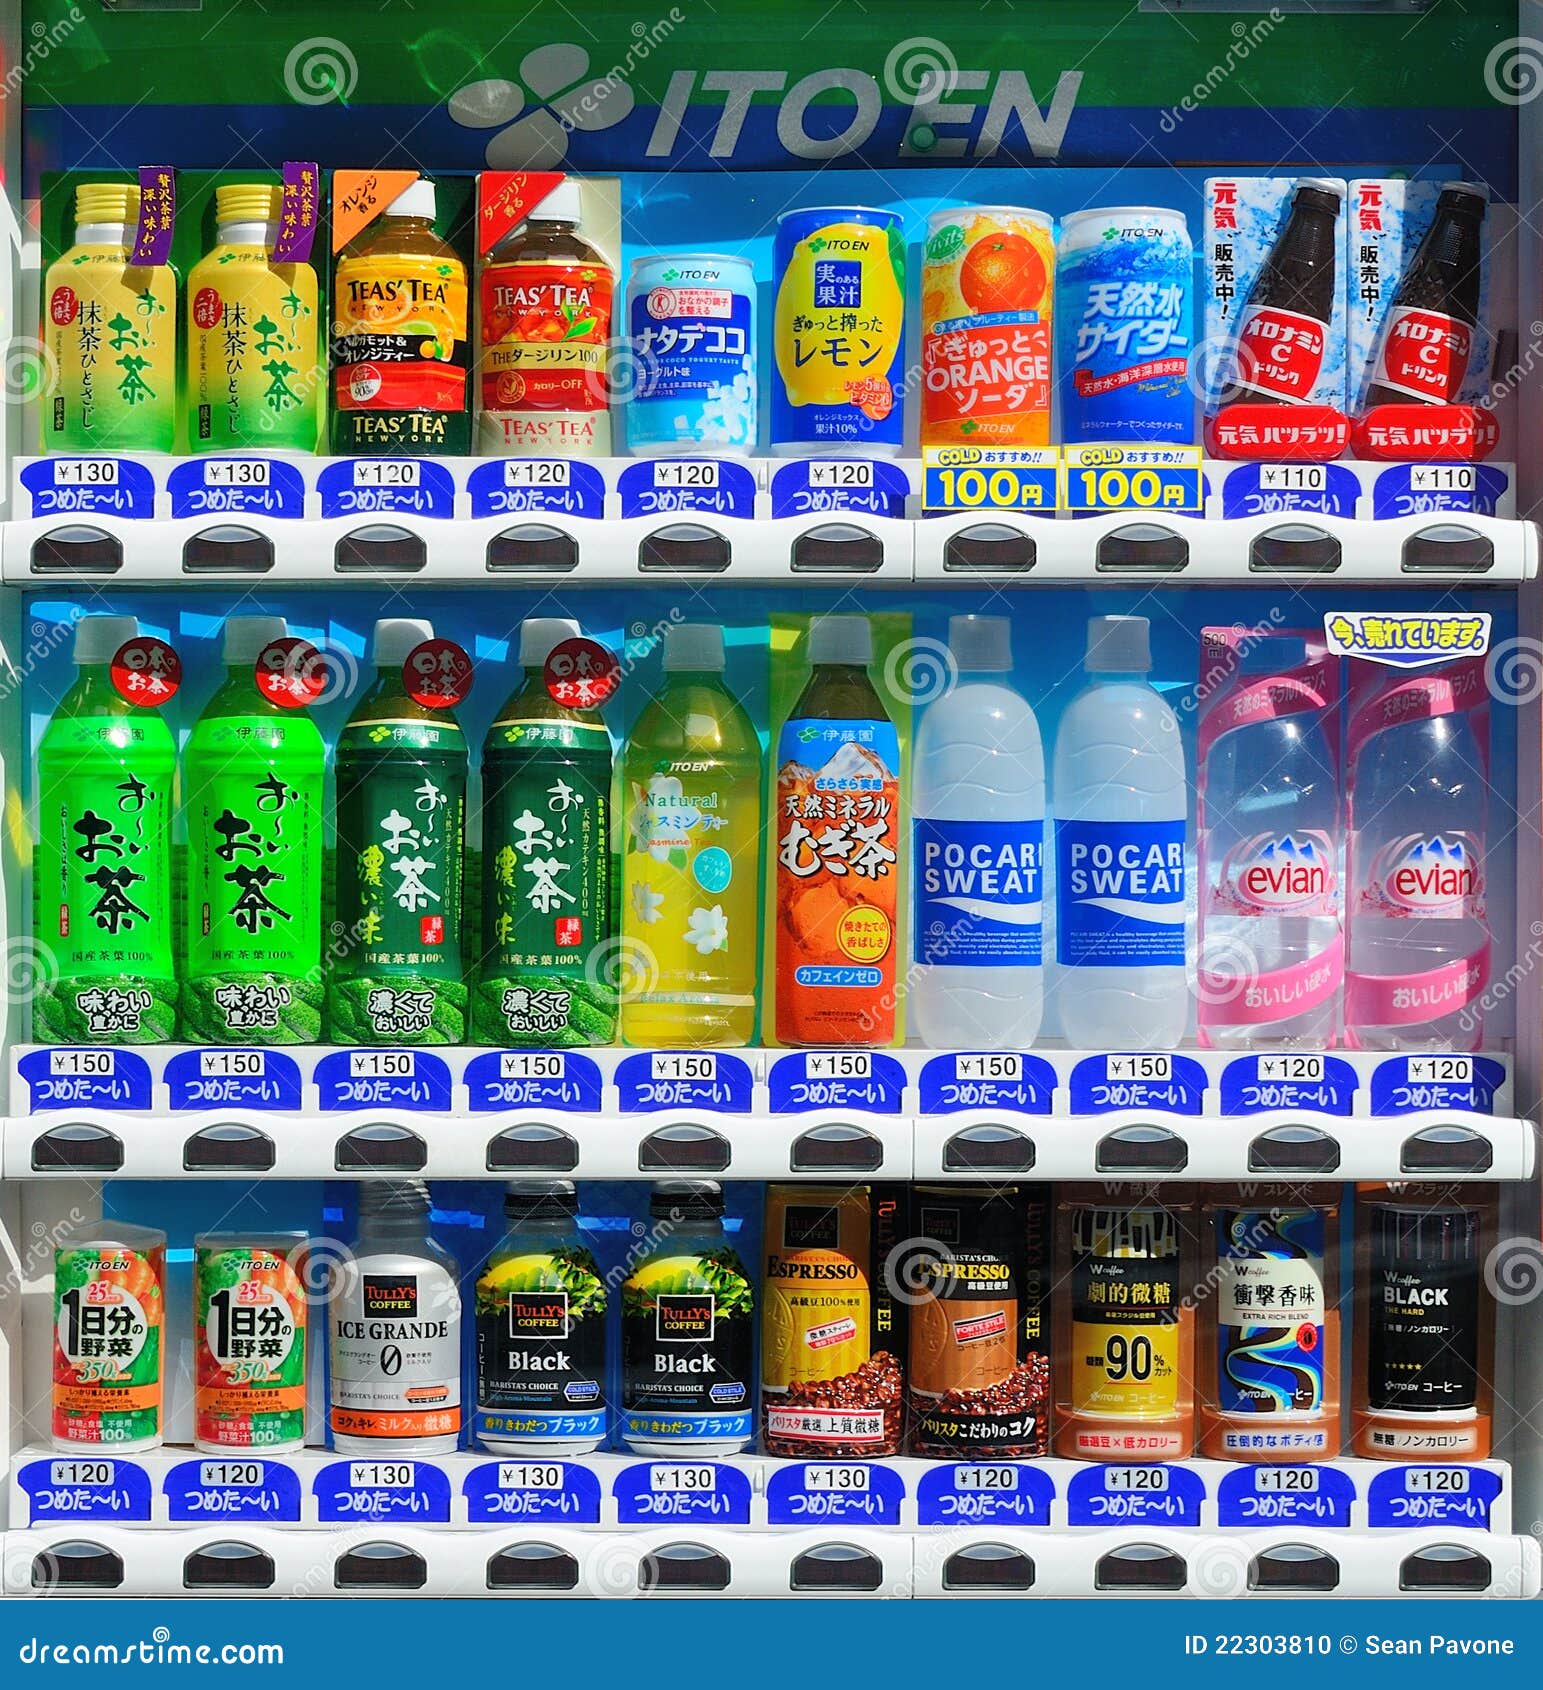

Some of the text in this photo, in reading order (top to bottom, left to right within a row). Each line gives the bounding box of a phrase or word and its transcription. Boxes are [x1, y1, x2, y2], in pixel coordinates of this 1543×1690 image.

[644, 68, 1086, 160] ITO EN
[139, 188, 157, 258] 深い味わい
[279, 185, 299, 253] 深い味わい
[826, 240, 870, 251] ITO EN
[679, 269, 720, 280] ITO EN
[817, 285, 859, 305] 果汁
[1083, 282, 1184, 320] 天然水
[792, 312, 883, 333] ぎゅっと搾った
[635, 322, 745, 356] ナタデココ
[1076, 319, 1189, 362] サイダー
[1246, 318, 1323, 355] オロナミン
[1394, 319, 1468, 357] オロナミン
[794, 337, 884, 368] レモン
[1270, 344, 1293, 363] C
[1419, 345, 1441, 365] C
[77, 300, 102, 430] 抹茶ひとさじ
[221, 302, 248, 434] 抹茶ひとさじ
[926, 355, 1049, 392] ORANGE
[1253, 362, 1300, 386] ドリンク
[1401, 363, 1448, 387] ドリンク
[815, 422, 858, 435] 果汁10%
[977, 424, 1015, 433] ITO EN
[355, 435, 444, 444] NEW YORK
[504, 437, 593, 446] NEW YORK
[58, 462, 115, 482] ¥130
[208, 463, 266, 483] ¥130
[358, 464, 414, 484] ¥120
[508, 463, 565, 483] ¥120
[657, 465, 715, 485] ¥120
[812, 464, 870, 484] ¥120
[1264, 468, 1322, 488] ¥110
[1414, 469, 1472, 489] ¥110
[938, 470, 1043, 506] 100円
[1080, 470, 1185, 506] 100円
[1203, 633, 1226, 646] 500
[1329, 616, 1485, 650] 今、売れています。
[821, 728, 874, 742] 伊藤園
[669, 762, 710, 771] ITO EN
[815, 778, 884, 791] さらさら実感
[645, 792, 718, 808] Natural
[785, 794, 892, 820] 天然ミネラル
[778, 819, 897, 880] むぎ茶
[1071, 842, 1185, 869] POCAR
[380, 809, 441, 913] お茶
[512, 809, 577, 914] お茶
[73, 809, 151, 935] お茶
[213, 809, 292, 934] お茶
[924, 869, 1037, 894] SWEAT
[1071, 869, 1183, 894] SWEAT
[1247, 861, 1324, 895] evian
[1395, 862, 1474, 896] evian
[844, 920, 886, 932] 焼きたての
[846, 936, 885, 949] 香ばしさ
[800, 969, 879, 984] カフェインゼロ
[77, 988, 152, 1014] 味わい
[214, 984, 292, 1010] 味わい
[368, 989, 435, 1014] 濃くて
[503, 988, 571, 1014] 濃くて
[89, 1013, 141, 1033] 豊かに
[226, 1008, 278, 1030] 豊かに
[54, 1053, 111, 1073] ¥150
[204, 1054, 261, 1074] ¥150
[354, 1054, 411, 1074] ¥150
[504, 1056, 562, 1076] ¥150
[655, 1057, 714, 1077] ¥150
[810, 1055, 868, 1075] ¥150
[960, 1056, 1018, 1076] ¥150
[1110, 1057, 1168, 1077] ¥150
[1263, 1058, 1321, 1078] ¥120
[1411, 1059, 1469, 1080] ¥120
[89, 1260, 129, 1270] ITO EN
[240, 1260, 280, 1270] ITO EN
[767, 1255, 858, 1280] ESPRESSO
[1087, 1282, 1171, 1304] 劇的微糖
[1233, 1283, 1316, 1307] 衝撃香味
[1383, 1286, 1449, 1307] BLACK
[369, 1300, 411, 1310] COFFEE
[1400, 1307, 1425, 1317] HARD
[518, 1318, 559, 1328] COFFEE
[664, 1320, 706, 1330] COFFEE
[1242, 1312, 1267, 1320] EXTRA
[1287, 1312, 1309, 1320] BLEND
[337, 1320, 449, 1340] ICE GRANDE
[81, 1338, 133, 1357] 野菜
[231, 1339, 283, 1358] 野菜
[1105, 1334, 1151, 1381] 90
[508, 1351, 571, 1371] Black
[654, 1354, 716, 1374] Black
[528, 1382, 559, 1391] CHOICE
[673, 1384, 705, 1393] CHOICE
[1422, 1382, 1463, 1393] コーヒー
[67, 1428, 133, 1442] 野菜汁100%
[218, 1429, 282, 1443] 野菜汁100%
[55, 1463, 110, 1484] ¥120
[205, 1464, 260, 1485] ¥120
[353, 1464, 411, 1485] ¥130
[501, 1466, 559, 1487] ¥130
[655, 1467, 713, 1489] ¥130
[808, 1467, 867, 1488] ¥130
[959, 1467, 1014, 1489] ¥120
[1109, 1469, 1164, 1490] ¥120
[1259, 1469, 1315, 1491] ¥120
[1409, 1470, 1465, 1491] ¥120
